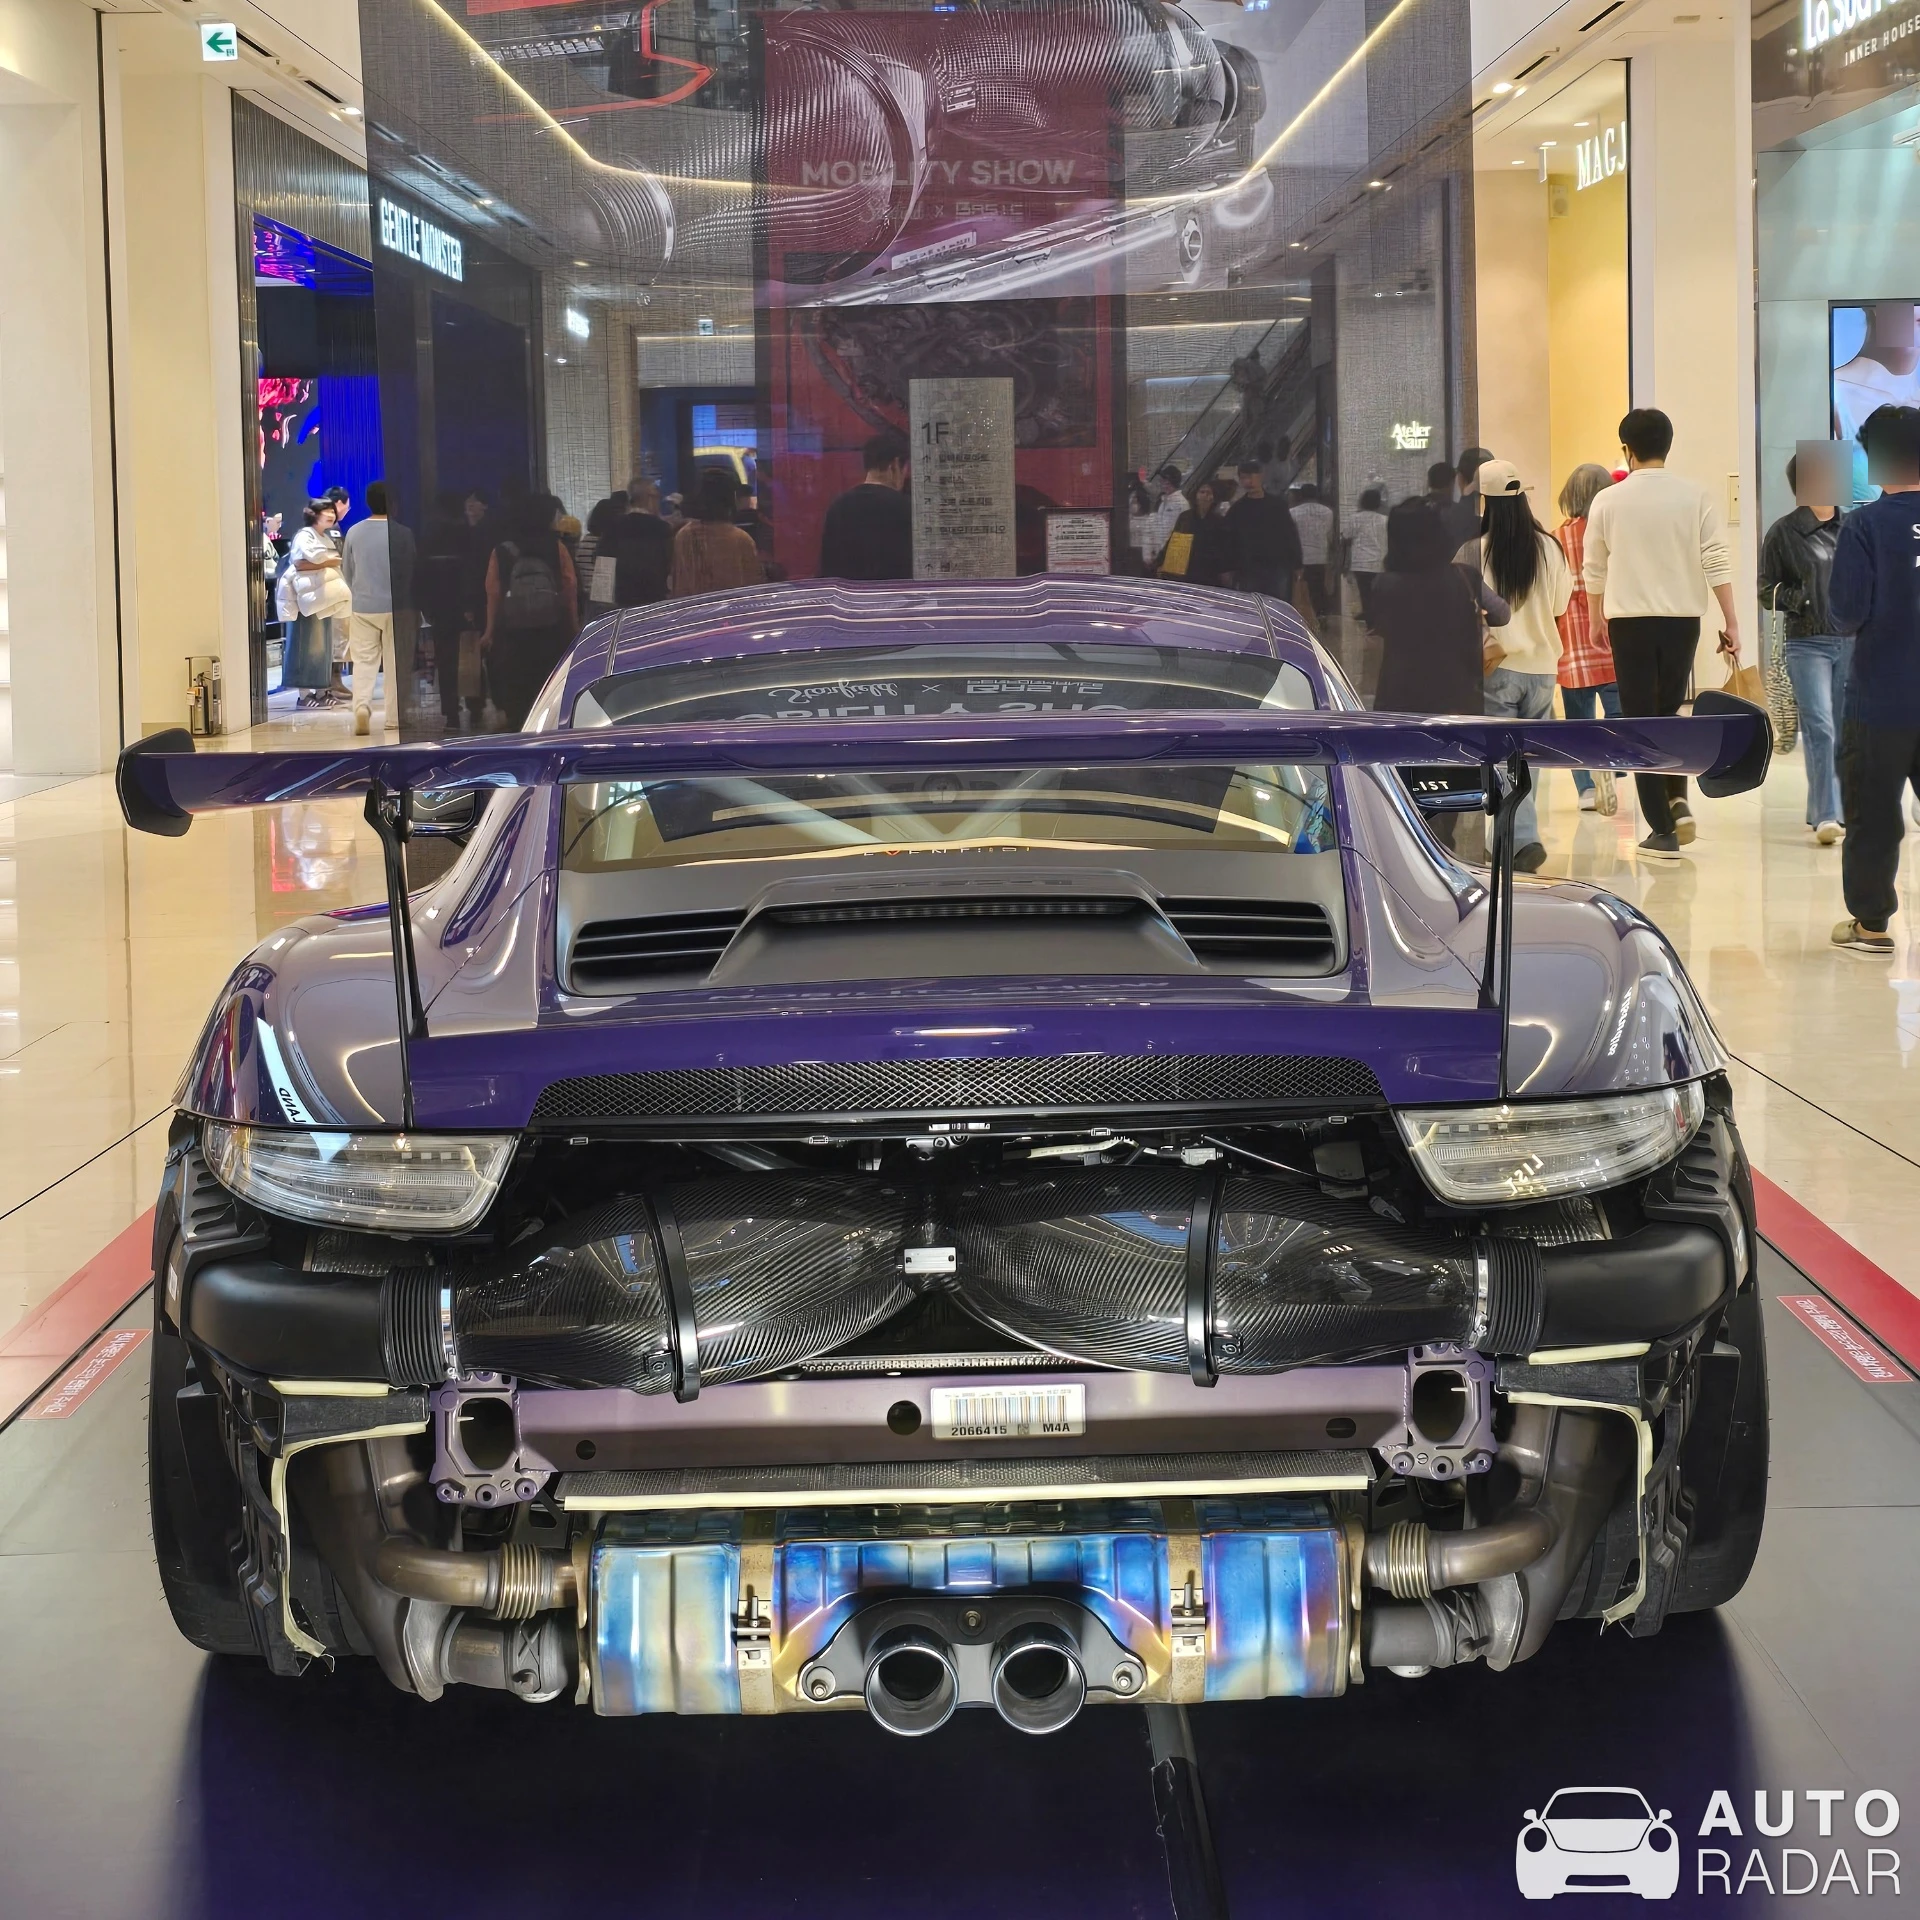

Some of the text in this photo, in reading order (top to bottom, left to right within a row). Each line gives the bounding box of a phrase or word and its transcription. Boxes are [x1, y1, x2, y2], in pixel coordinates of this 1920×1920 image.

[1804, 0, 1829, 50] La
[1845, 14, 1920, 66] INNER HOUSE
[803, 159, 1075, 186] MOBLITY SHOW
[380, 197, 463, 282] GENTLE MONSTER
[922, 422, 949, 445] 1F
[1391, 421, 1432, 438] Atelier
[951, 1423, 1070, 1436] 2066415 M4A
